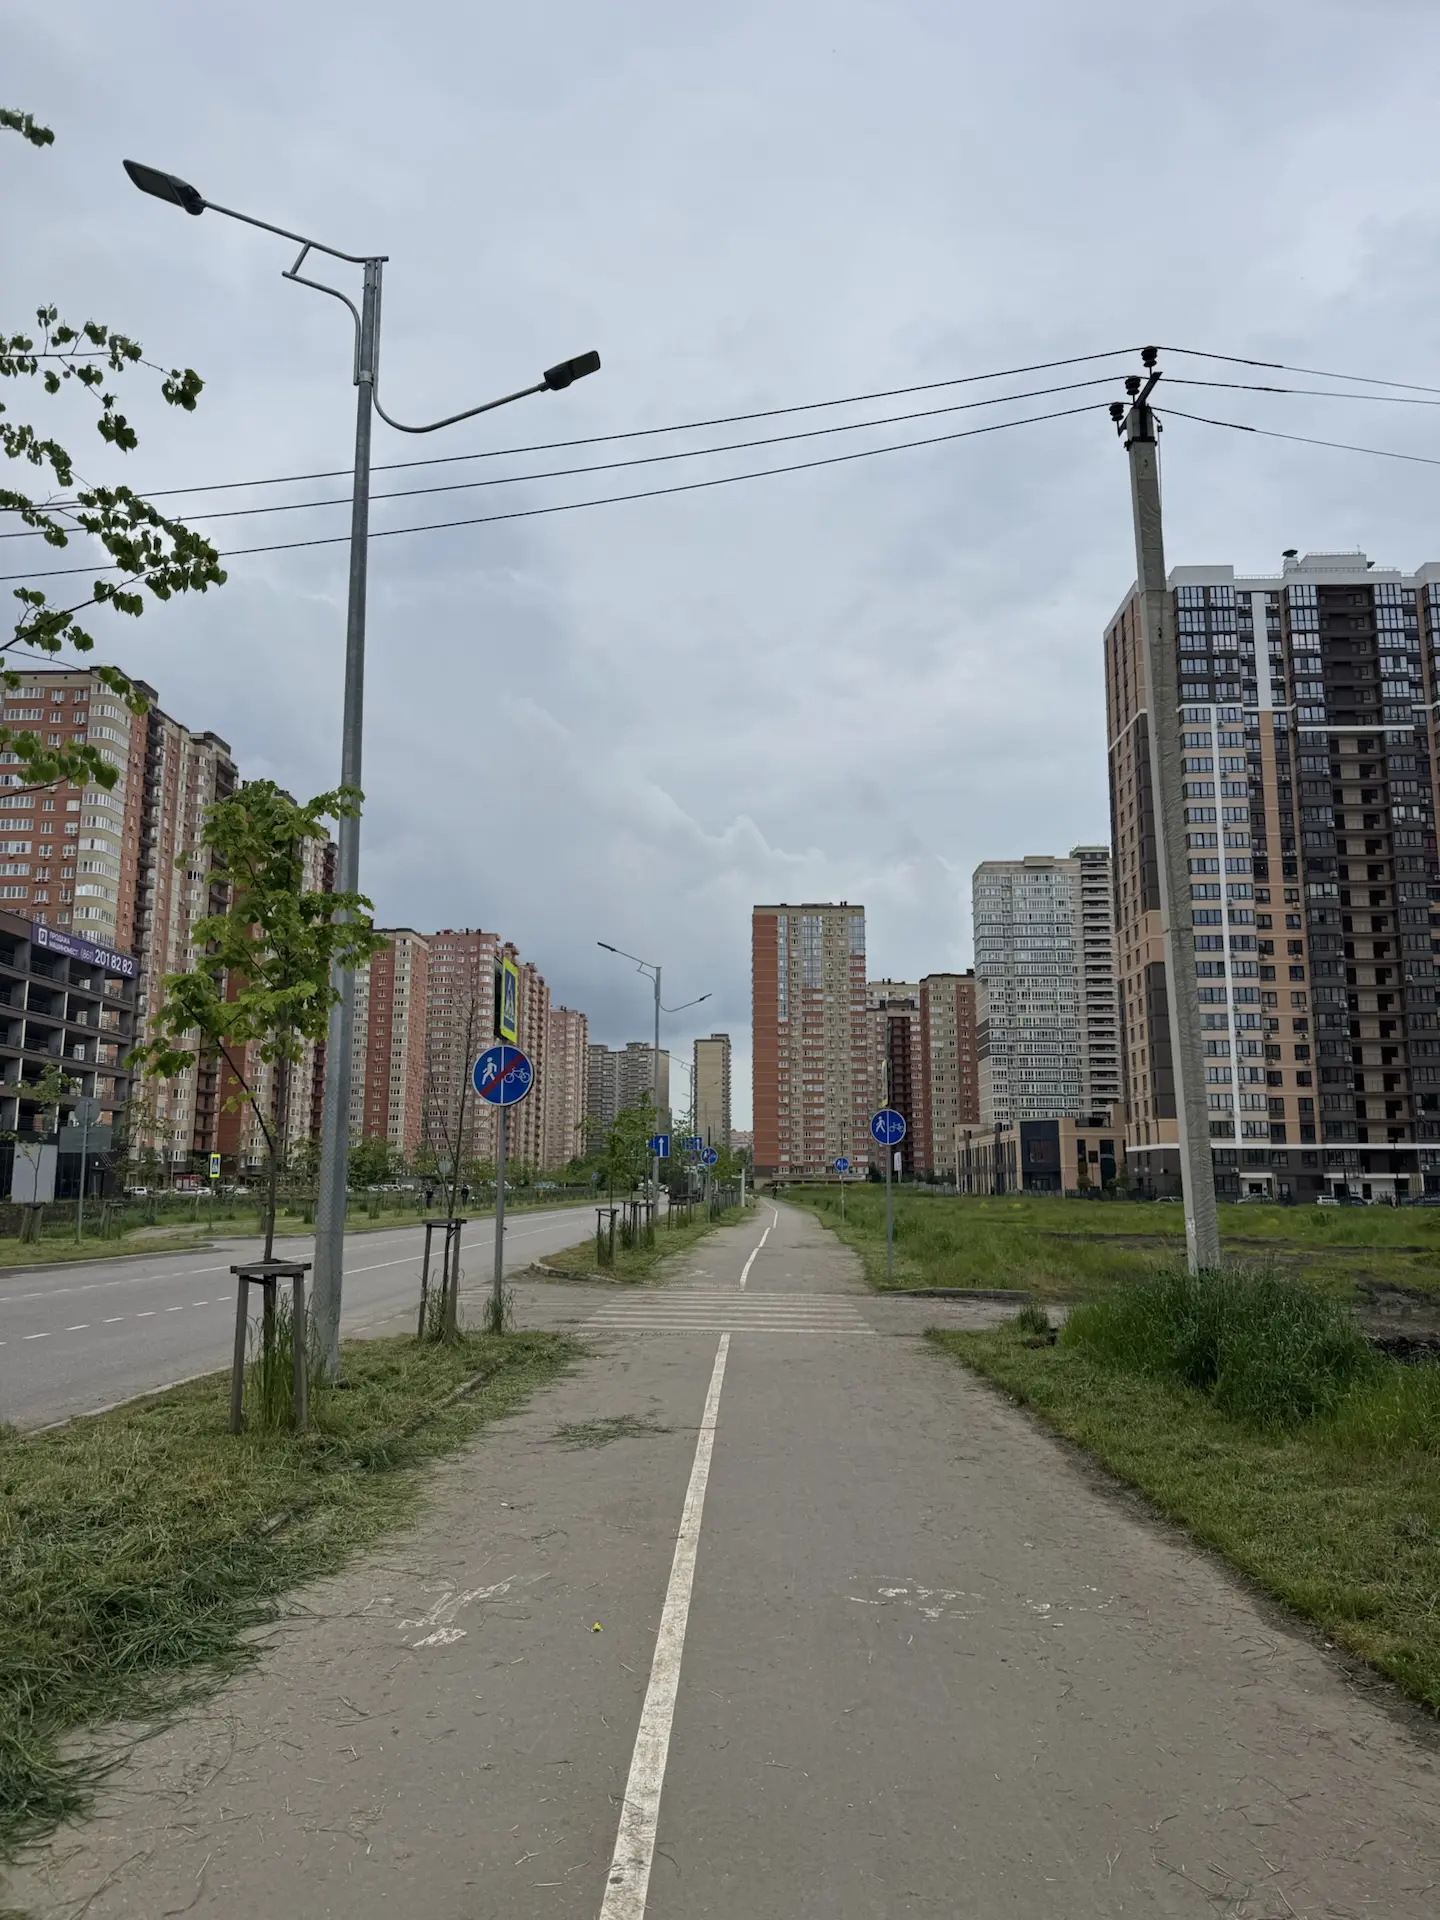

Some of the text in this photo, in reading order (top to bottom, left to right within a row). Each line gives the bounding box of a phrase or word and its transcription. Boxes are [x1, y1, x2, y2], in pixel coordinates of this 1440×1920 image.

[49, 931, 71, 945] ПРОДАЖА
[95, 949, 110, 967] 201
[110, 955, 122, 971] 82
[123, 959, 133, 975] 82
